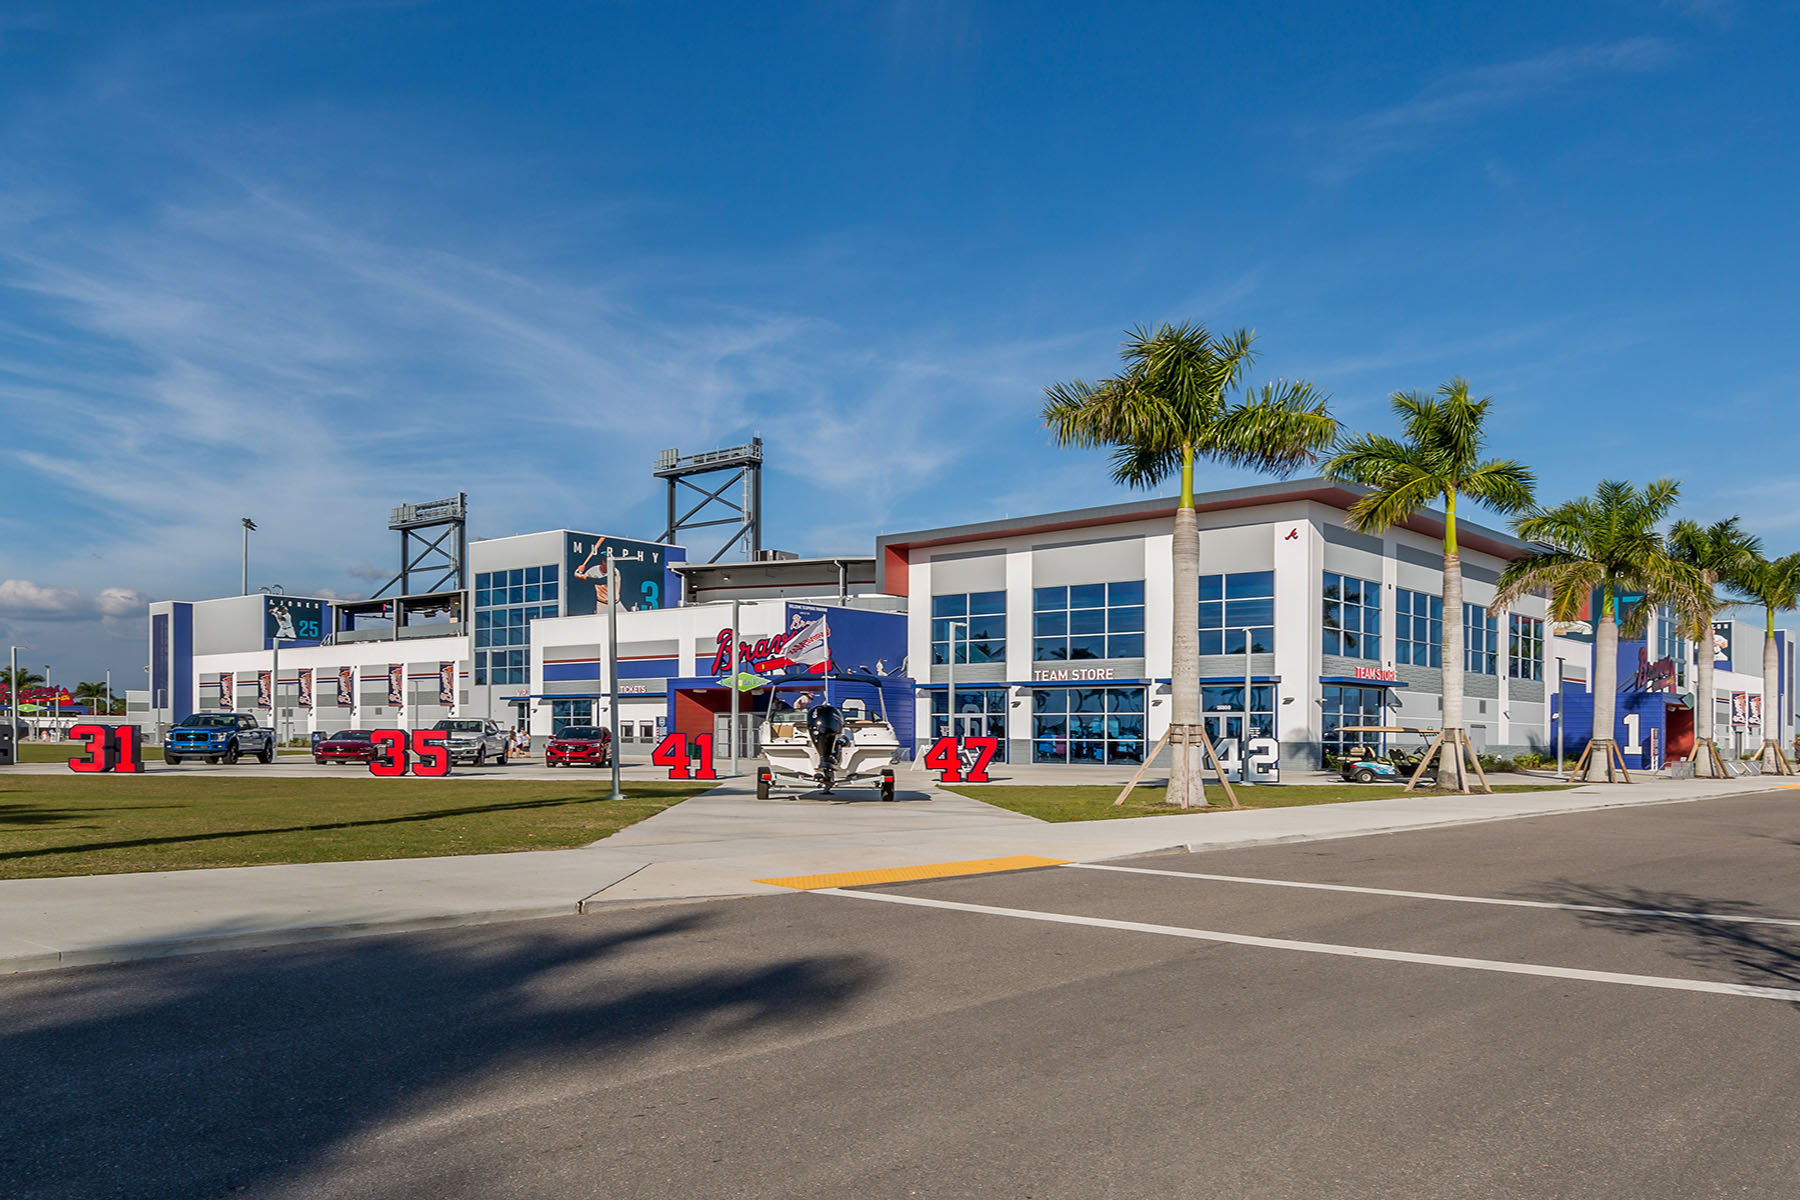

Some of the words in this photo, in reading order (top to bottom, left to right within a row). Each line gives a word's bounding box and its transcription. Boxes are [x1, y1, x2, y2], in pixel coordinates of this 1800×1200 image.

[573, 541, 660, 564] MURPHY
[640, 580, 659, 611] 3
[299, 620, 319, 638] 25
[620, 685, 648, 694] TICKETS
[1034, 669, 1070, 681] TEAM
[1071, 668, 1114, 681] STORE
[68, 724, 140, 773] 31
[369, 729, 451, 777] 35
[1623, 713, 1643, 755] 1
[652, 733, 717, 779] 41
[924, 736, 998, 783] 47
[1202, 737, 1280, 783] 42
